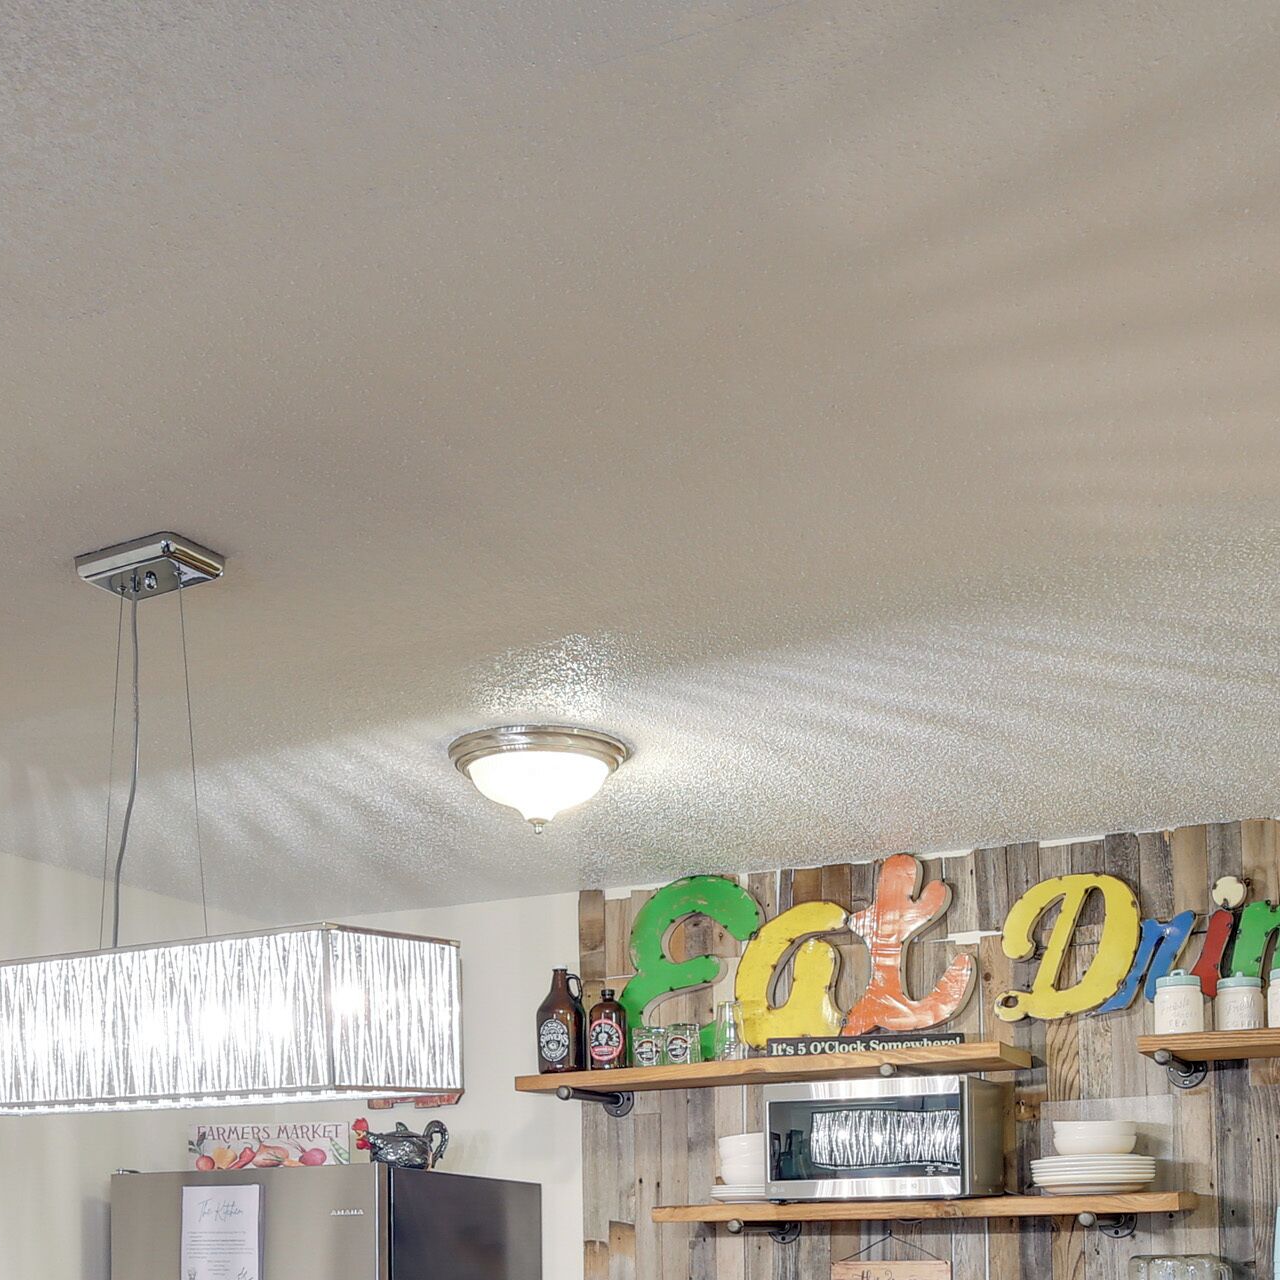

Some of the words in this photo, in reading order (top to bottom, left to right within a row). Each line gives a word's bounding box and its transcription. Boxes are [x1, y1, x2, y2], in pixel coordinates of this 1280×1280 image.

[619, 853, 977, 1057] Eat
[771, 1043, 794, 1056] It's
[797, 1044, 806, 1055] 5
[810, 1040, 867, 1054] O'Clock
[197, 1125, 271, 1143] FARMERS
[277, 1123, 342, 1142] MARKET
